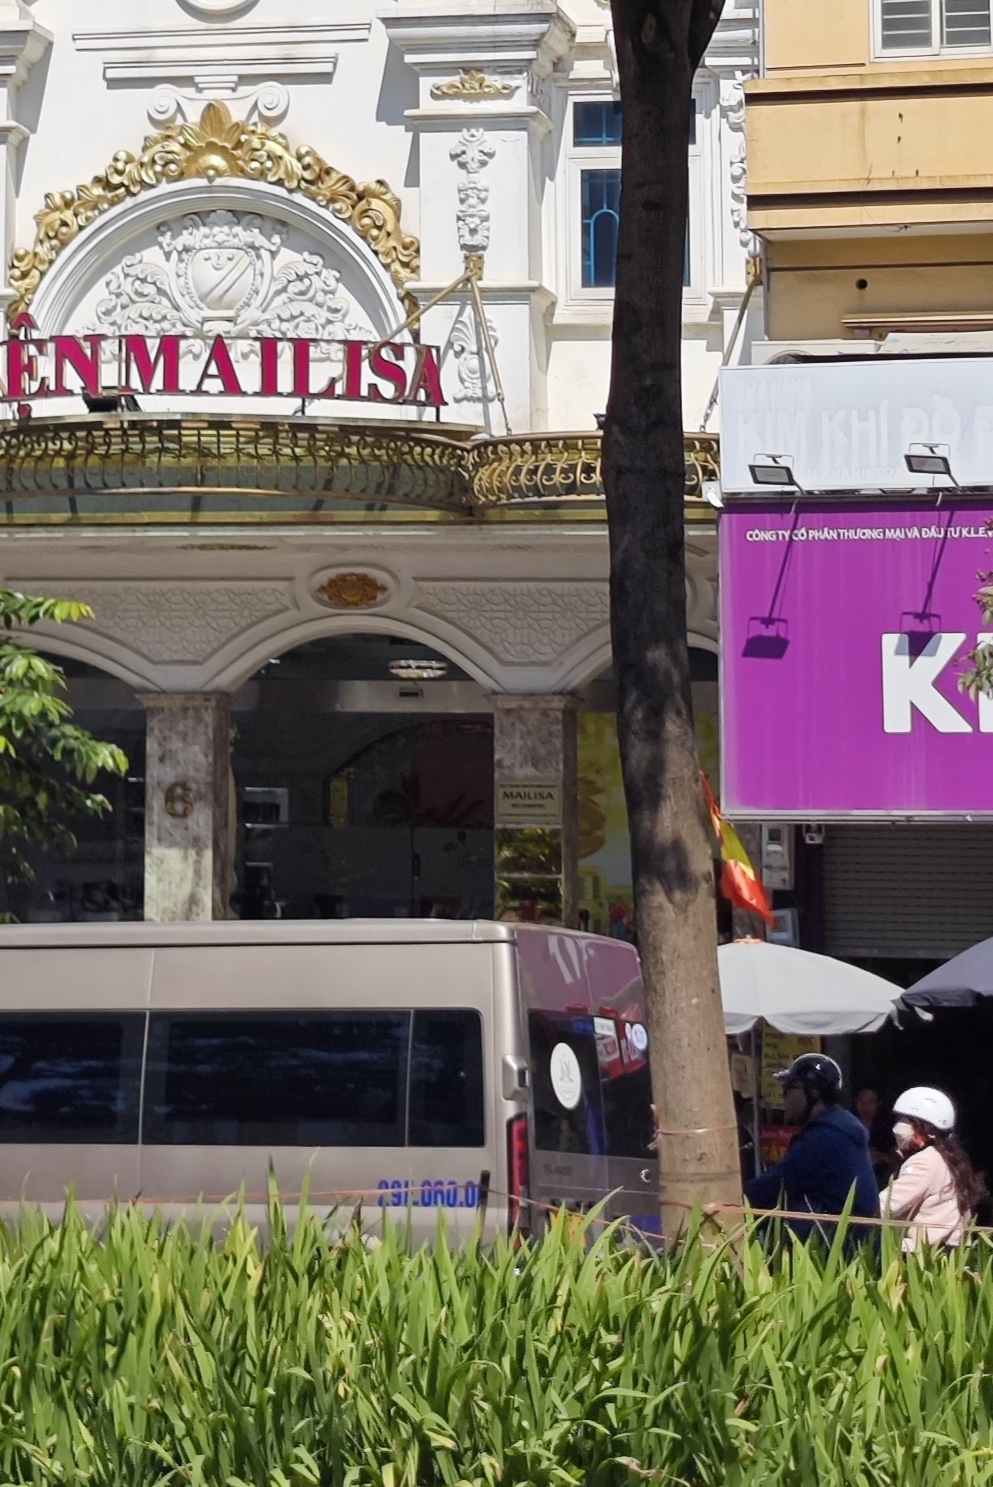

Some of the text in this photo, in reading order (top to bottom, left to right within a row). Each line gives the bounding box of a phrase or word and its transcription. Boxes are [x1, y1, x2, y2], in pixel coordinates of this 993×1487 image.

[120, 334, 448, 407] MAILISA
[745, 528, 776, 541] CÔNG
[777, 529, 791, 541] TY
[502, 790, 555, 801] MAILISA
